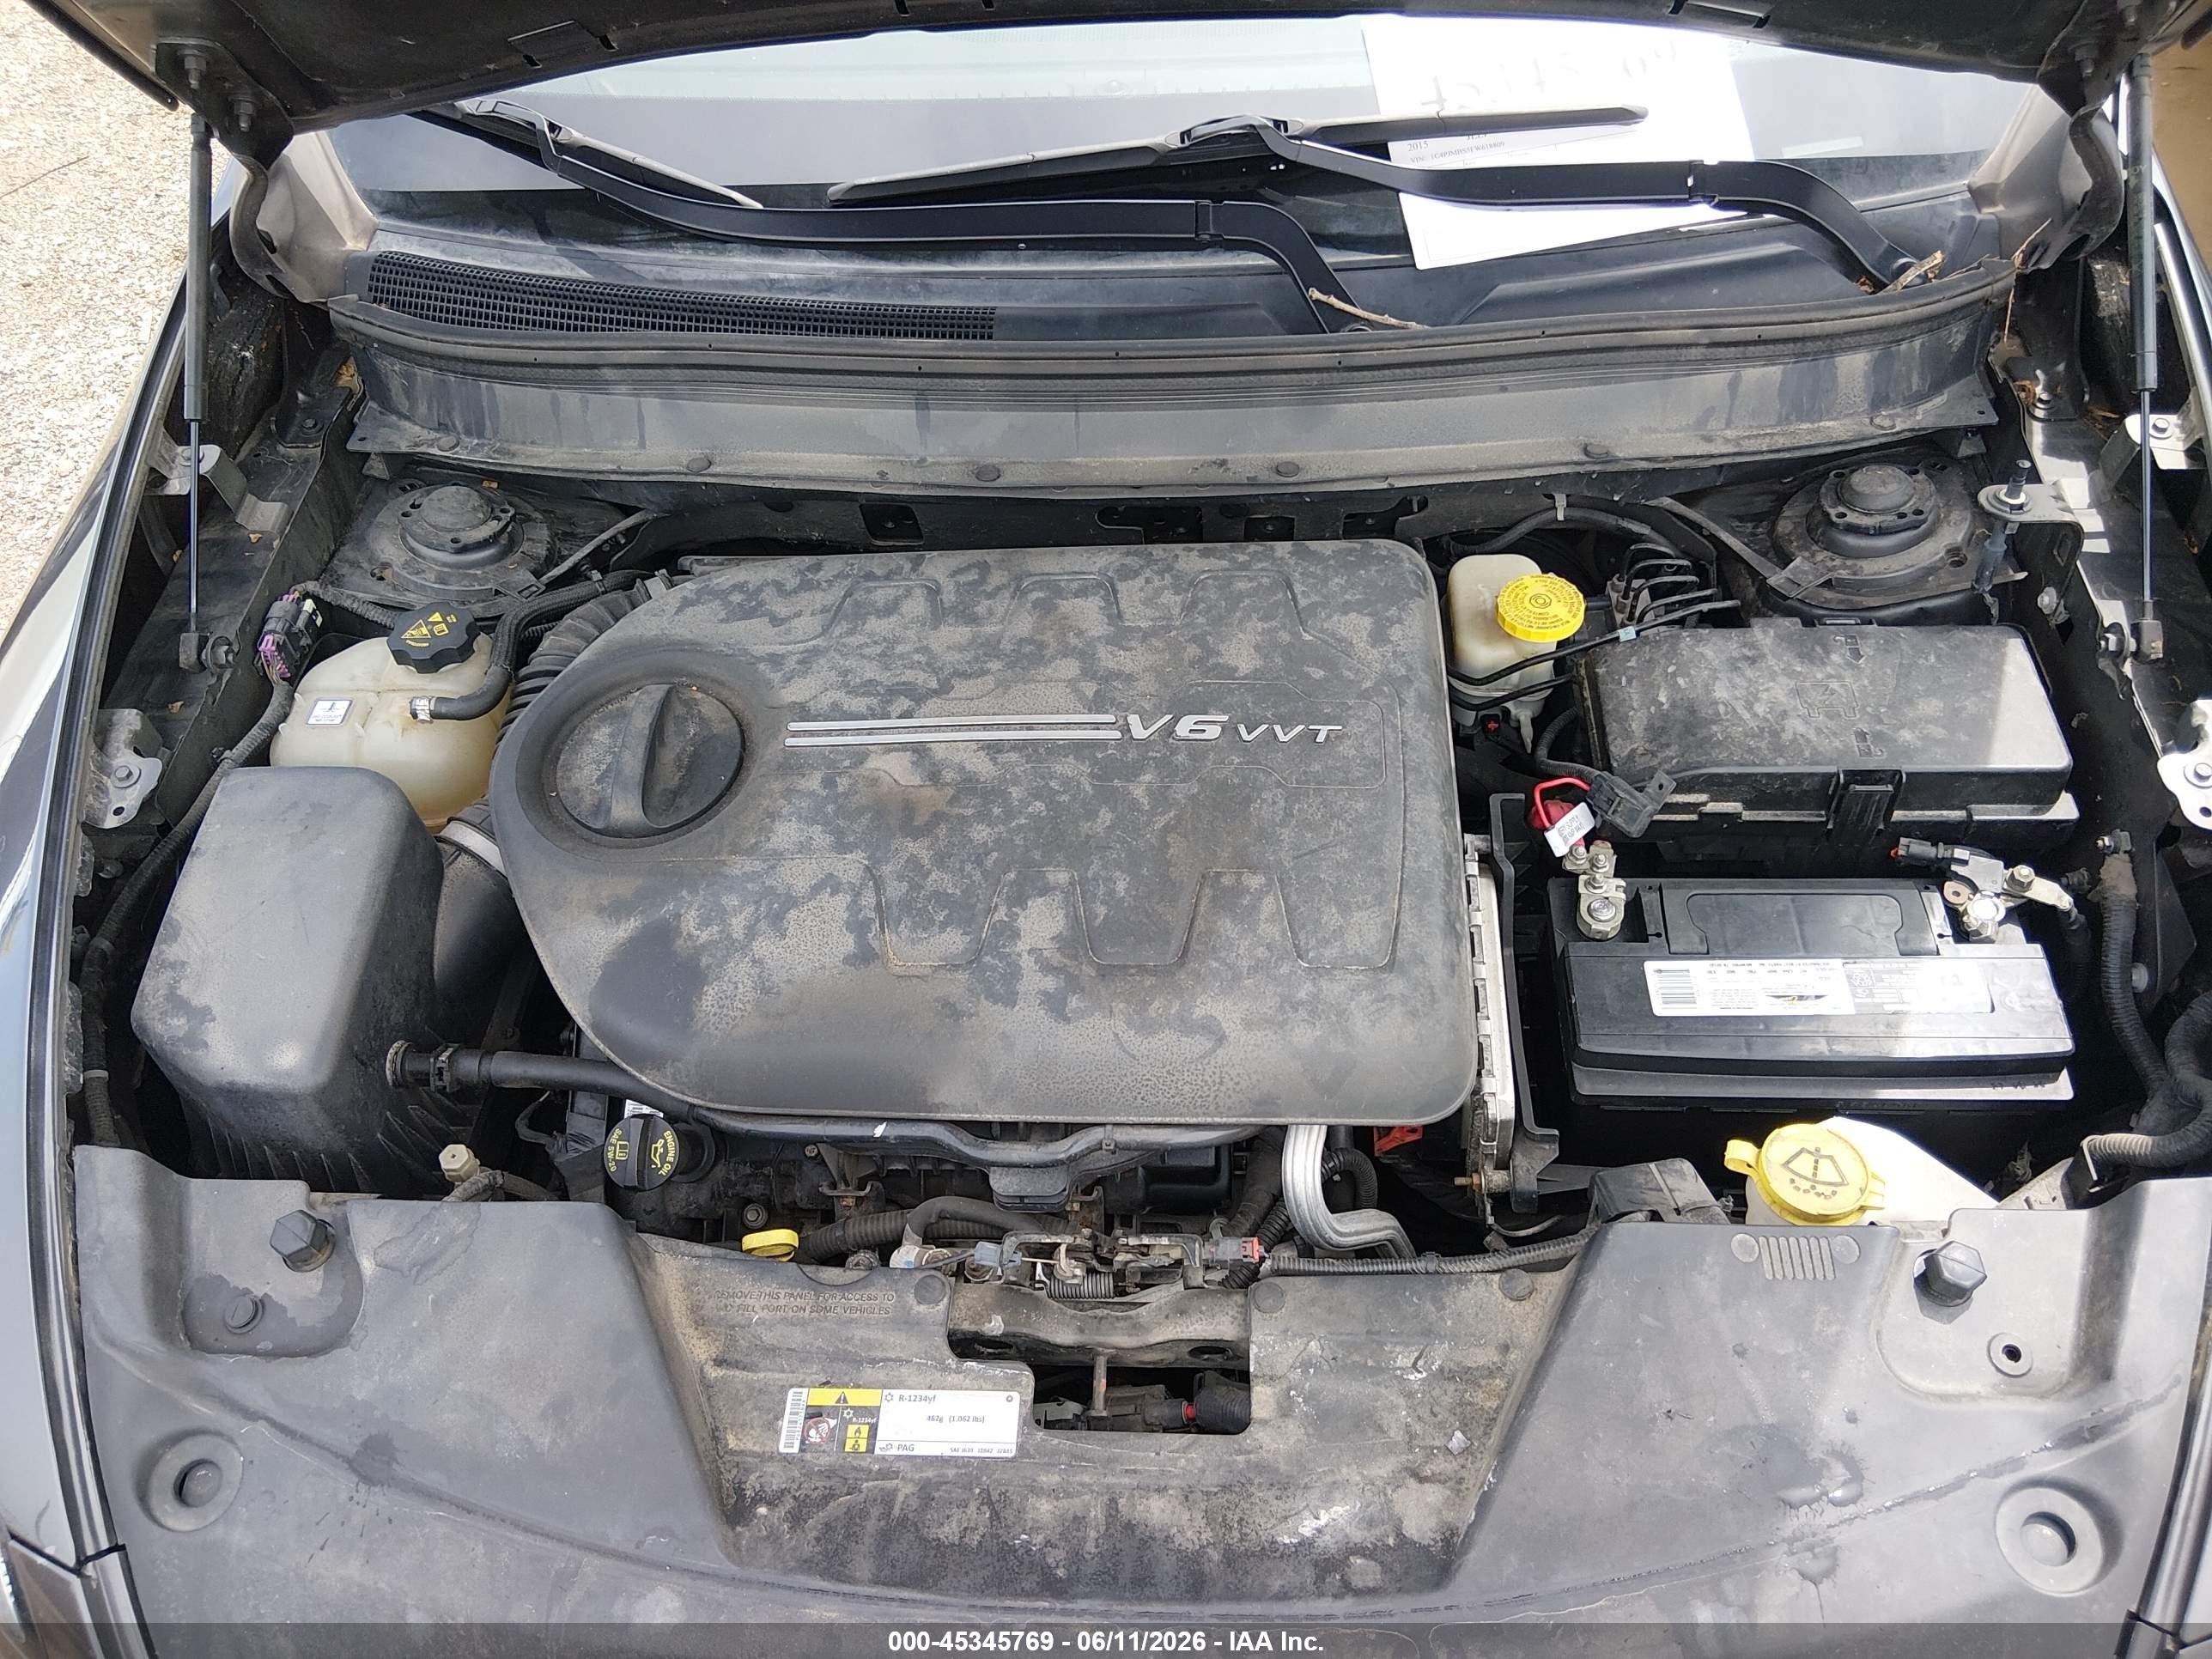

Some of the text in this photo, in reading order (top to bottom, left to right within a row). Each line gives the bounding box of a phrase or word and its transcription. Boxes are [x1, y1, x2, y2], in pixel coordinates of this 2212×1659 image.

[1407, 140, 1430, 152] 2015
[1127, 714, 1342, 743] V6 VVT
[606, 1127, 623, 1173] SAE 5W-20
[657, 1129, 676, 1176] ENGINE OIL
[757, 1290, 781, 1301] THIS
[782, 1291, 815, 1301] PANEL
[817, 1292, 837, 1302] FOR
[840, 1292, 879, 1302] ACCESS
[882, 1292, 896, 1303] TO
[761, 1304, 787, 1314] PORT
[790, 1305, 808, 1314] ON
[810, 1305, 840, 1315] SOME
[842, 1306, 891, 1316] VEHICLES
[898, 1394, 937, 1405] R-1234yf
[972, 1415, 985, 1424] lbs)
[896, 1443, 915, 1452] PAG
